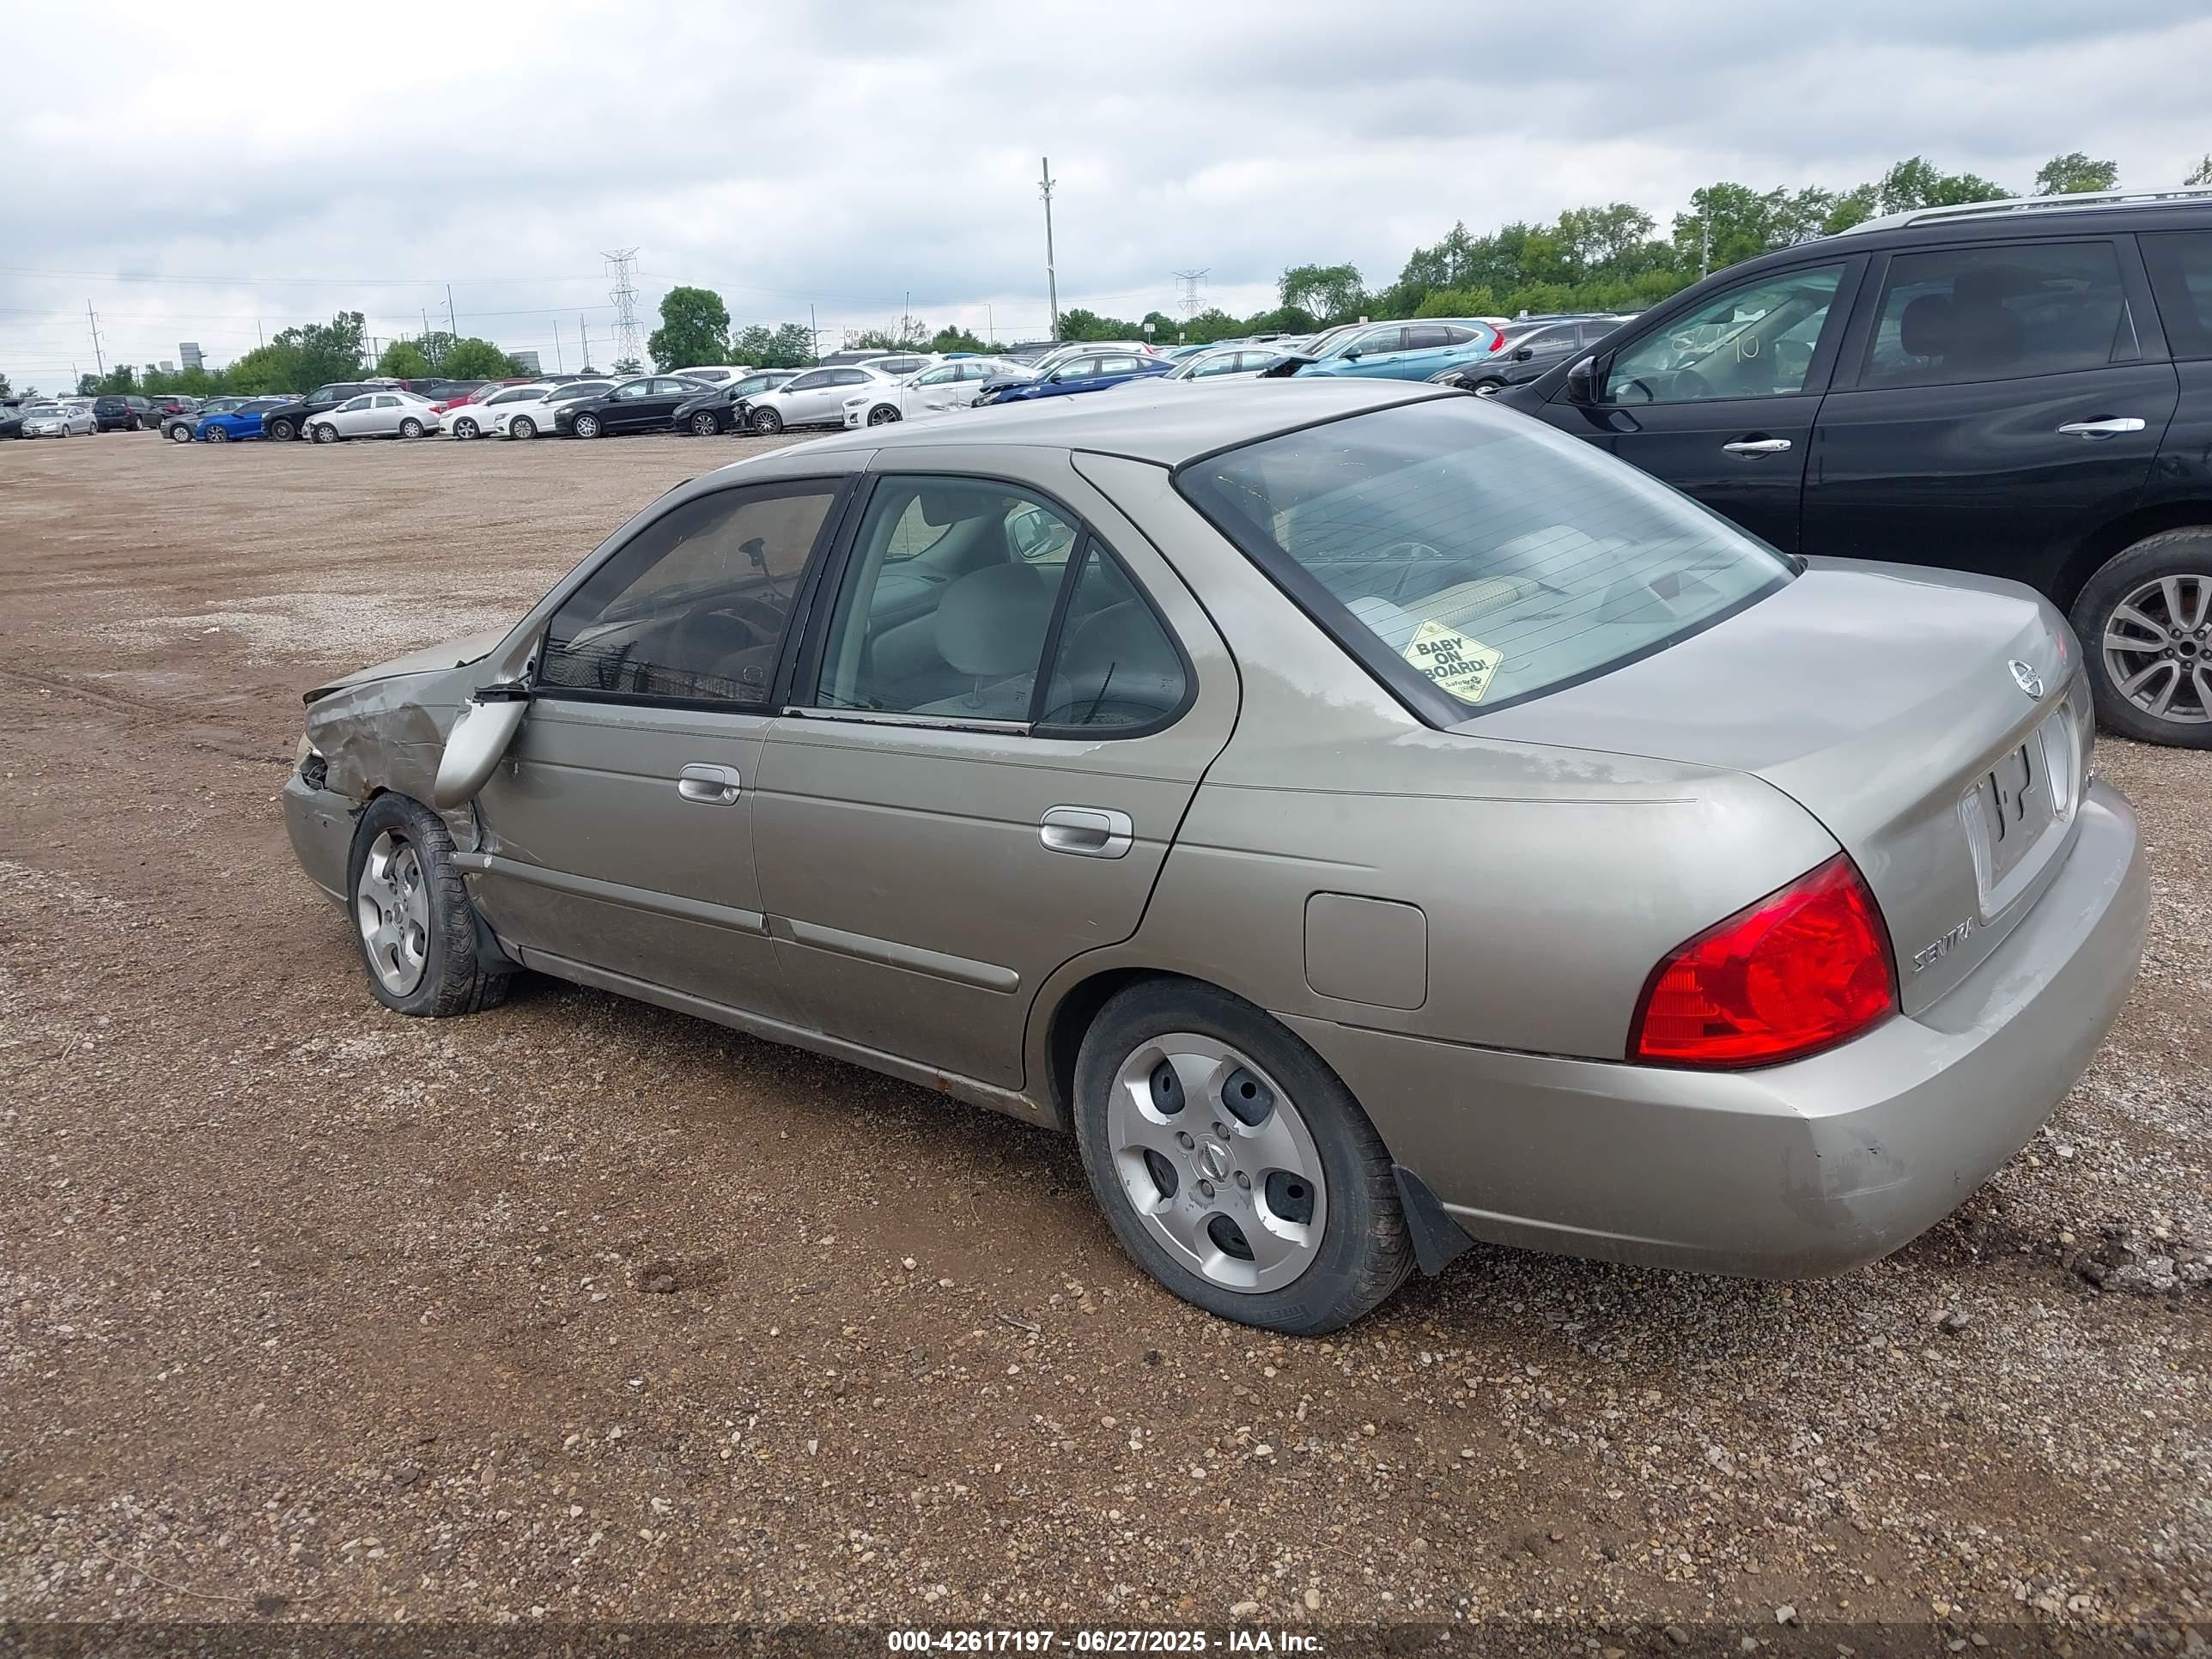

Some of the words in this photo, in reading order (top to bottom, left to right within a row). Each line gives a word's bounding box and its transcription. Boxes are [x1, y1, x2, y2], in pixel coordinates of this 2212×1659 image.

[1416, 637, 1464, 655] BABY
[1434, 650, 1463, 665] ON
[1424, 659, 1490, 681] BOARD!
[1911, 915, 1976, 974] SENTRA
